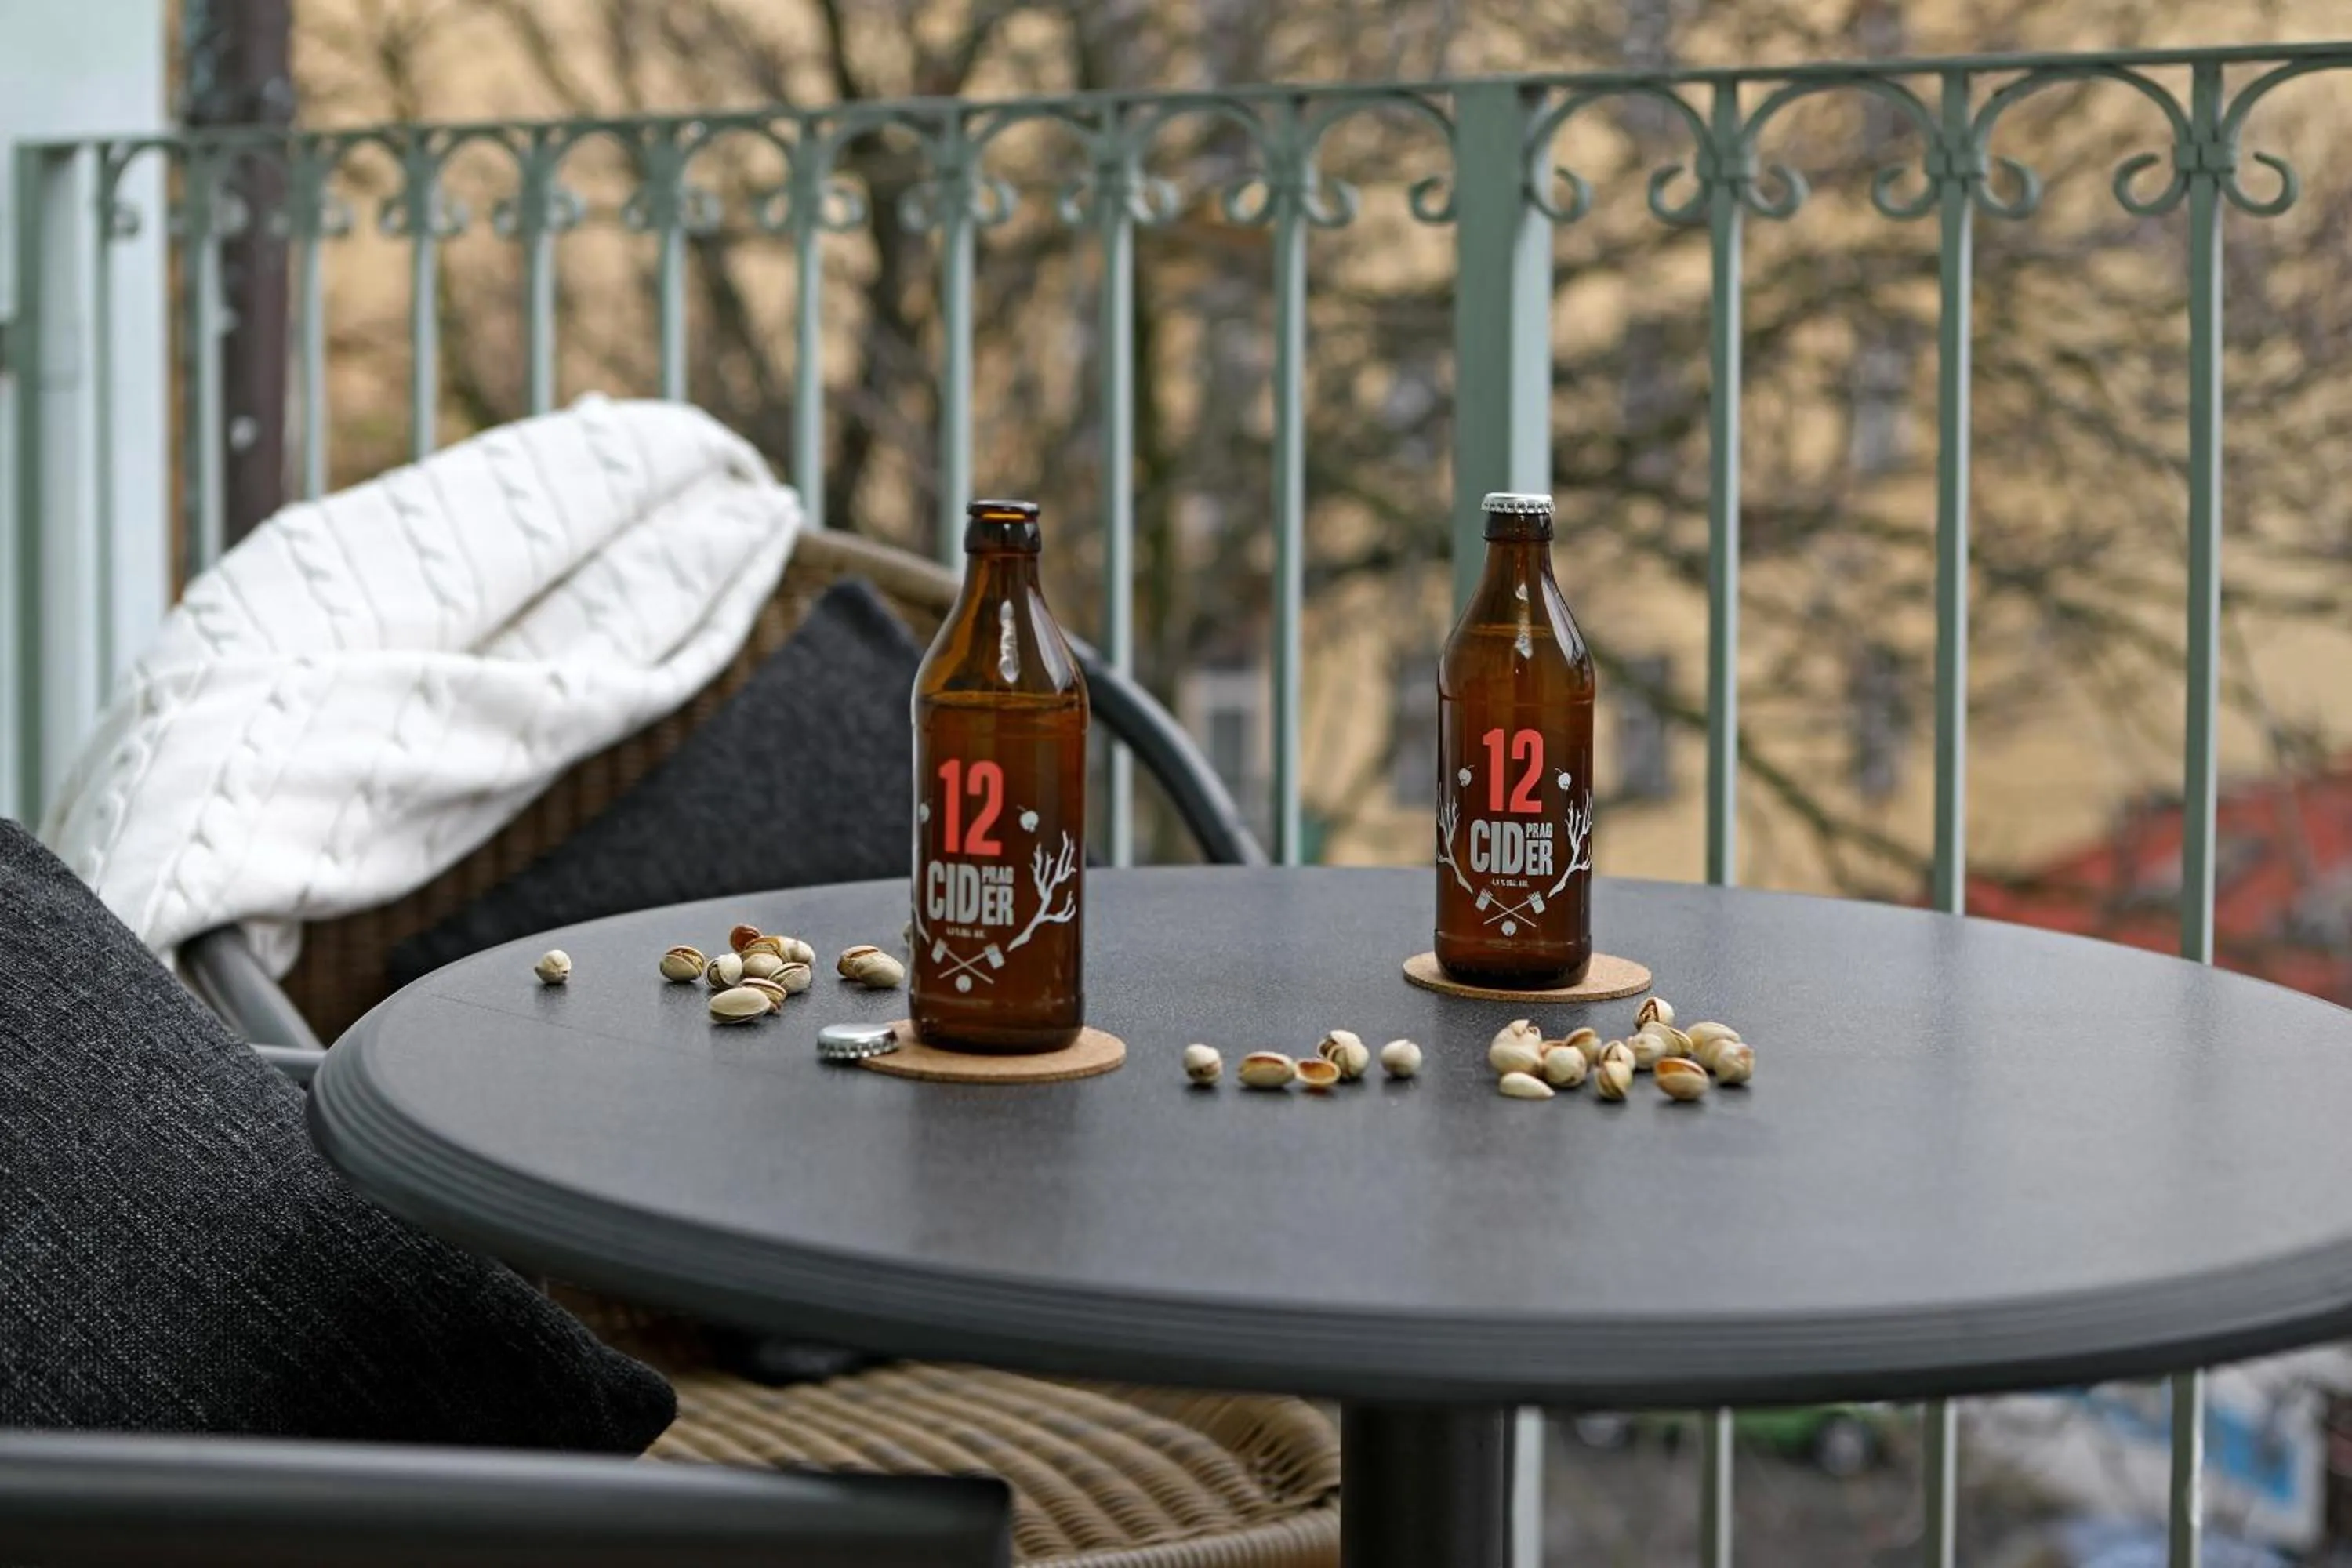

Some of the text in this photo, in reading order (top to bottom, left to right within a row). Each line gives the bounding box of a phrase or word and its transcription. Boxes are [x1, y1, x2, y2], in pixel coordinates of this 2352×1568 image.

[938, 759, 1004, 855] 12
[1483, 728, 1544, 812] 12
[1526, 822, 1553, 838] PRAG
